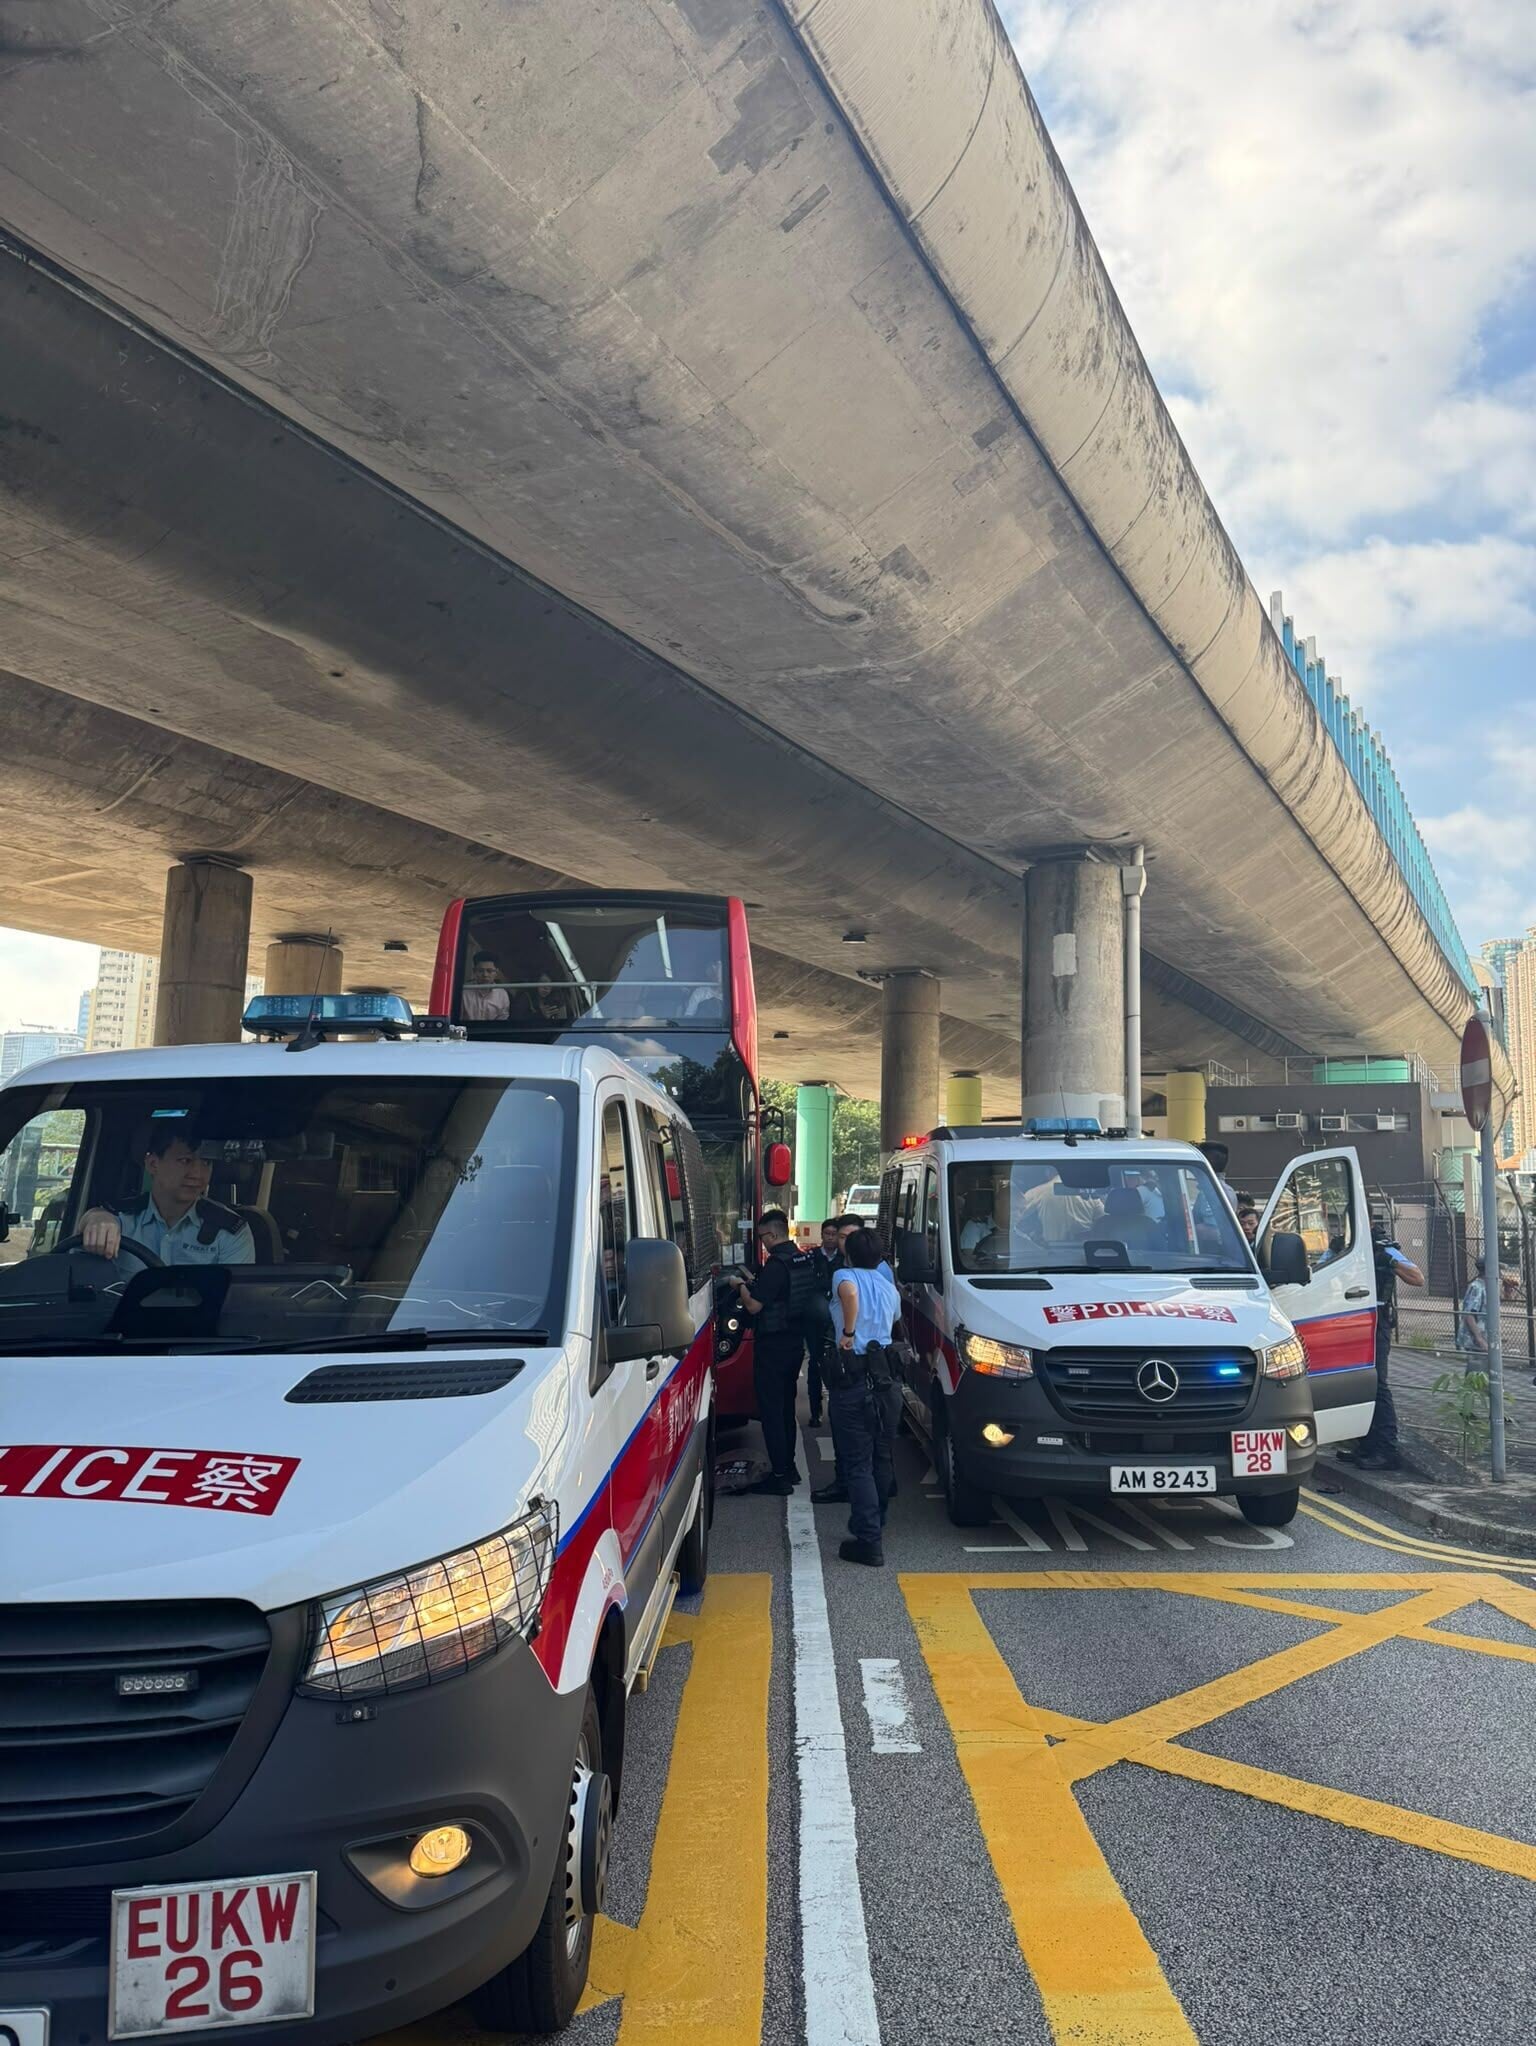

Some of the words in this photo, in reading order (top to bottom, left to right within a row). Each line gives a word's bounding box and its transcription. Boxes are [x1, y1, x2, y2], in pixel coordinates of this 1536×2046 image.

[1080, 1303, 1201, 1319] POLICE
[1234, 1432, 1283, 1453] EUKW
[1247, 1453, 1272, 1473] 28
[0, 1449, 196, 1501] ICE
[1118, 1471, 1146, 1488] AM
[1153, 1471, 1209, 1489] 8243
[128, 1883, 300, 1959] EUKW
[165, 1949, 263, 2020] 26
